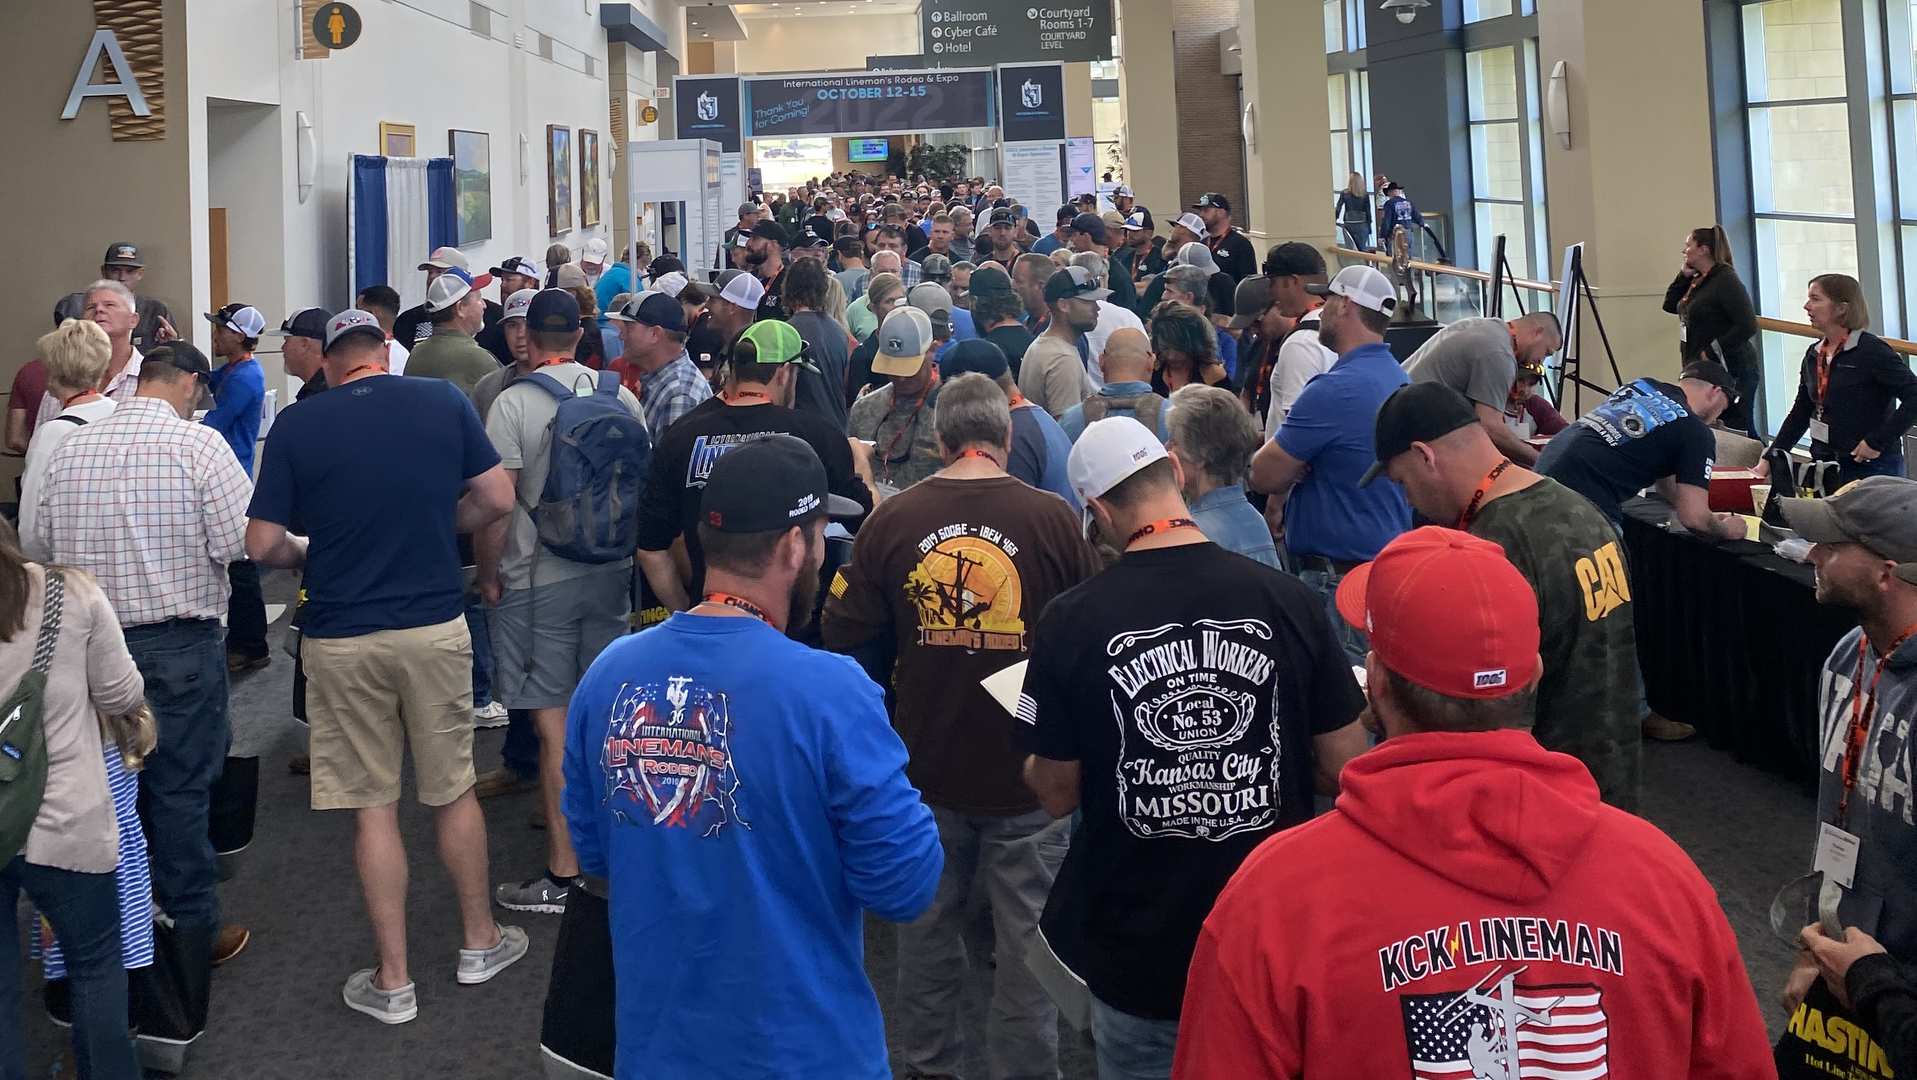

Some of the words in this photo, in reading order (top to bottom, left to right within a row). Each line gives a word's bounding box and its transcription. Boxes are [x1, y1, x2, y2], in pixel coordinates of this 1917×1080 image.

[944, 11, 988, 22] Ballroom
[1039, 6, 1090, 22] Courtyard
[1040, 20, 1075, 30] Rooms
[1077, 18, 1094, 29] 1-7
[944, 26, 972, 40] Cyber
[975, 25, 998, 36] Café
[1040, 31, 1086, 41] COURTYARD
[945, 41, 972, 53] Hotel
[1041, 41, 1064, 50] LEVEL
[60, 30, 152, 119] A
[783, 79, 844, 88] International
[846, 76, 893, 86] Lineman's
[895, 75, 924, 84] Rodeo
[926, 74, 934, 83] &
[936, 74, 959, 85] Expo
[817, 87, 882, 100] OCTOBER
[886, 85, 927, 98] 12-15
[754, 103, 784, 119] Thank
[786, 98, 804, 110] You
[755, 118, 770, 130] for
[770, 105, 811, 124] Coming!
[797, 493, 814, 507] 2019
[917, 532, 939, 554] 2019
[979, 525, 1003, 544] IBEW
[1002, 538, 1019, 557] 465
[1575, 541, 1632, 622] CAT
[1107, 639, 1198, 699] ELECTRICAL
[1202, 630, 1275, 686] WORKERS
[1167, 676, 1185, 688] ON
[1188, 673, 1217, 684] TIME
[1177, 697, 1215, 713] Local
[668, 708, 686, 726] 36
[1172, 714, 1198, 730] No.
[1201, 710, 1222, 726] 53
[641, 725, 702, 742] INTERNATIONAL
[1178, 727, 1218, 740] UNION
[608, 736, 726, 770] LINEMAN'S
[1178, 750, 1222, 764] QUALITY
[643, 760, 698, 777] RODEO
[1132, 758, 1216, 786] Kansas
[1222, 753, 1263, 784] City
[1168, 782, 1236, 794] WORKMANSHIP
[1134, 785, 1269, 819] MISSOURI
[1162, 817, 1190, 828] MADE
[1191, 816, 1200, 825] IN
[1201, 817, 1218, 827] THE
[1220, 816, 1245, 827] U.S.A.
[1379, 925, 1456, 992] KCK
[1459, 917, 1624, 977] LINEMAN
[1788, 1002, 1895, 1080] HASTIN
